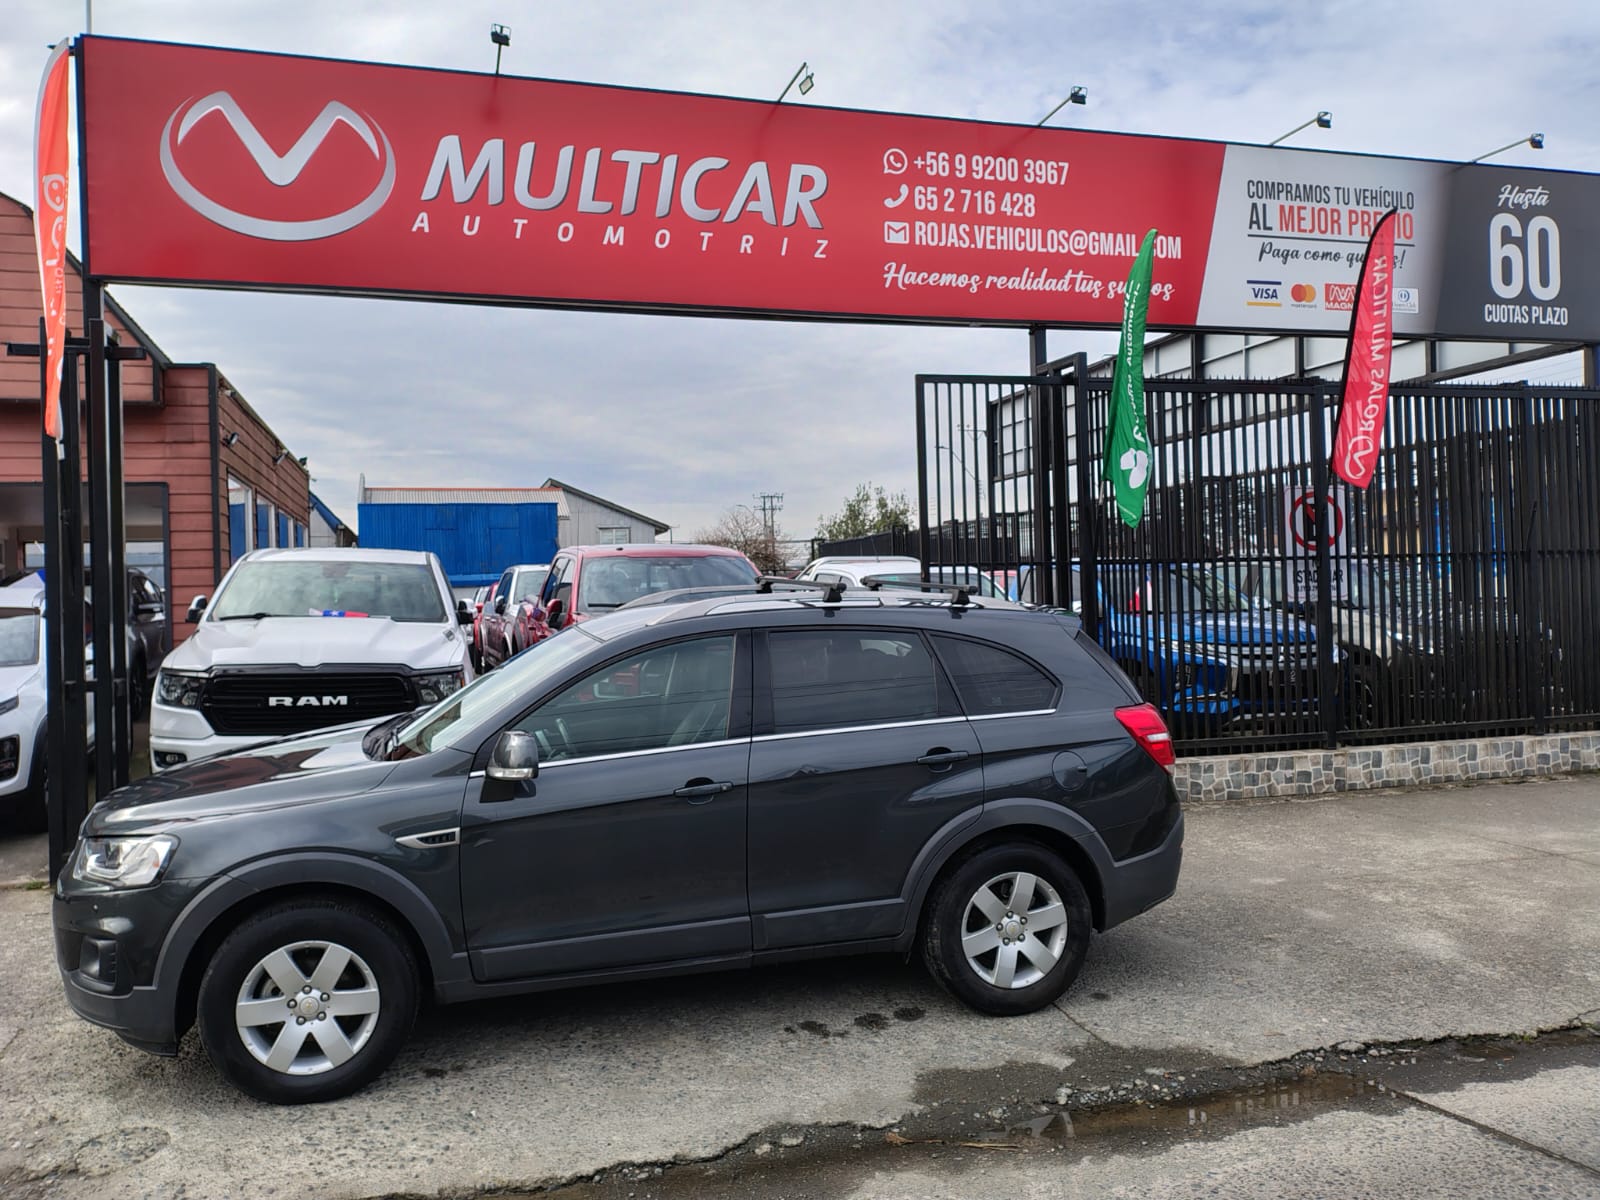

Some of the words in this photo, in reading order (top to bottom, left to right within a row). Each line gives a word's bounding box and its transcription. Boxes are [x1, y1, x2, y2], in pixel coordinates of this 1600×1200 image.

[421, 135, 829, 229] MULTICAR
[914, 151, 949, 177] +56
[955, 153, 966, 178] 9
[972, 155, 1018, 182] 9200
[1024, 159, 1069, 185] 3967
[914, 185, 938, 211] 65
[943, 188, 955, 212] 2
[960, 189, 995, 215] 716
[1001, 192, 1036, 217] 428
[1247, 180, 1330, 204] COMPRAMOS
[1334, 186, 1350, 206] TU
[1354, 186, 1415, 210] VEHÍCULO
[1498, 184, 1550, 209] Hasta
[411, 211, 830, 259] AUTOMOTRIZ
[1248, 203, 1273, 231] AL
[1279, 204, 1342, 236] MEJOR
[1348, 209, 1414, 240] PREIO
[914, 221, 1182, 259] ROJAS.VEHICULOS@GMAILOM
[1258, 242, 1301, 265] Paga
[1303, 251, 1343, 262] como
[1489, 212, 1561, 301] 60
[883, 262, 982, 293] Hacemos
[985, 268, 1070, 293] realidad
[1068, 270, 1104, 298] tus
[1107, 280, 1175, 301] suos
[1252, 287, 1279, 300] VISA
[1325, 302, 1355, 310] MAGN
[1484, 304, 1529, 324] CUOTAS
[1531, 306, 1568, 326] PLAZO
[268, 696, 348, 707] RAM
